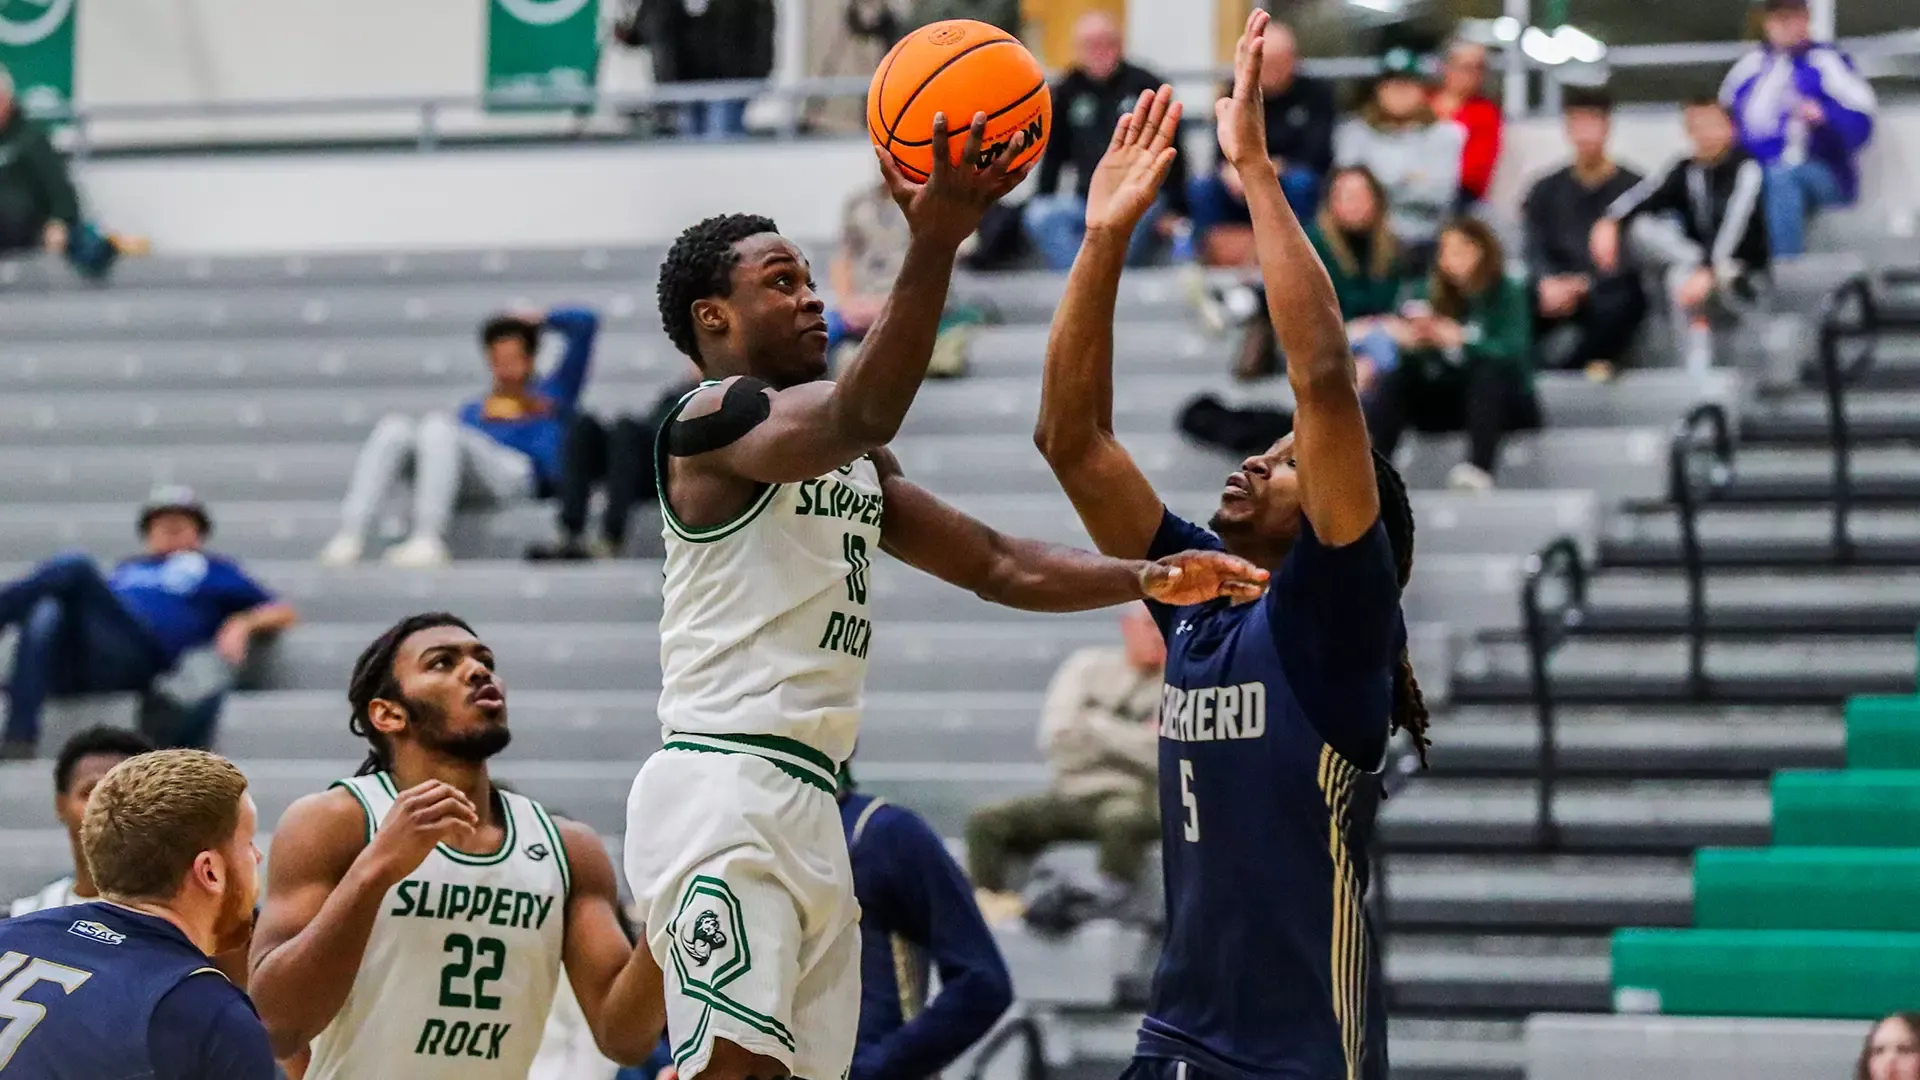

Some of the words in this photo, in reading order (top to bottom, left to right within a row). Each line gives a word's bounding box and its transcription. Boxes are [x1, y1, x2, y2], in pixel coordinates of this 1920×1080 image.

[843, 532, 869, 605] 10
[819, 611, 872, 659] ROCK
[1179, 759, 1200, 843] 5
[391, 880, 554, 930] SLIPPERY
[72, 920, 122, 943] PSAC
[439, 933, 506, 1010] 22
[414, 1018, 512, 1060] ROCK
